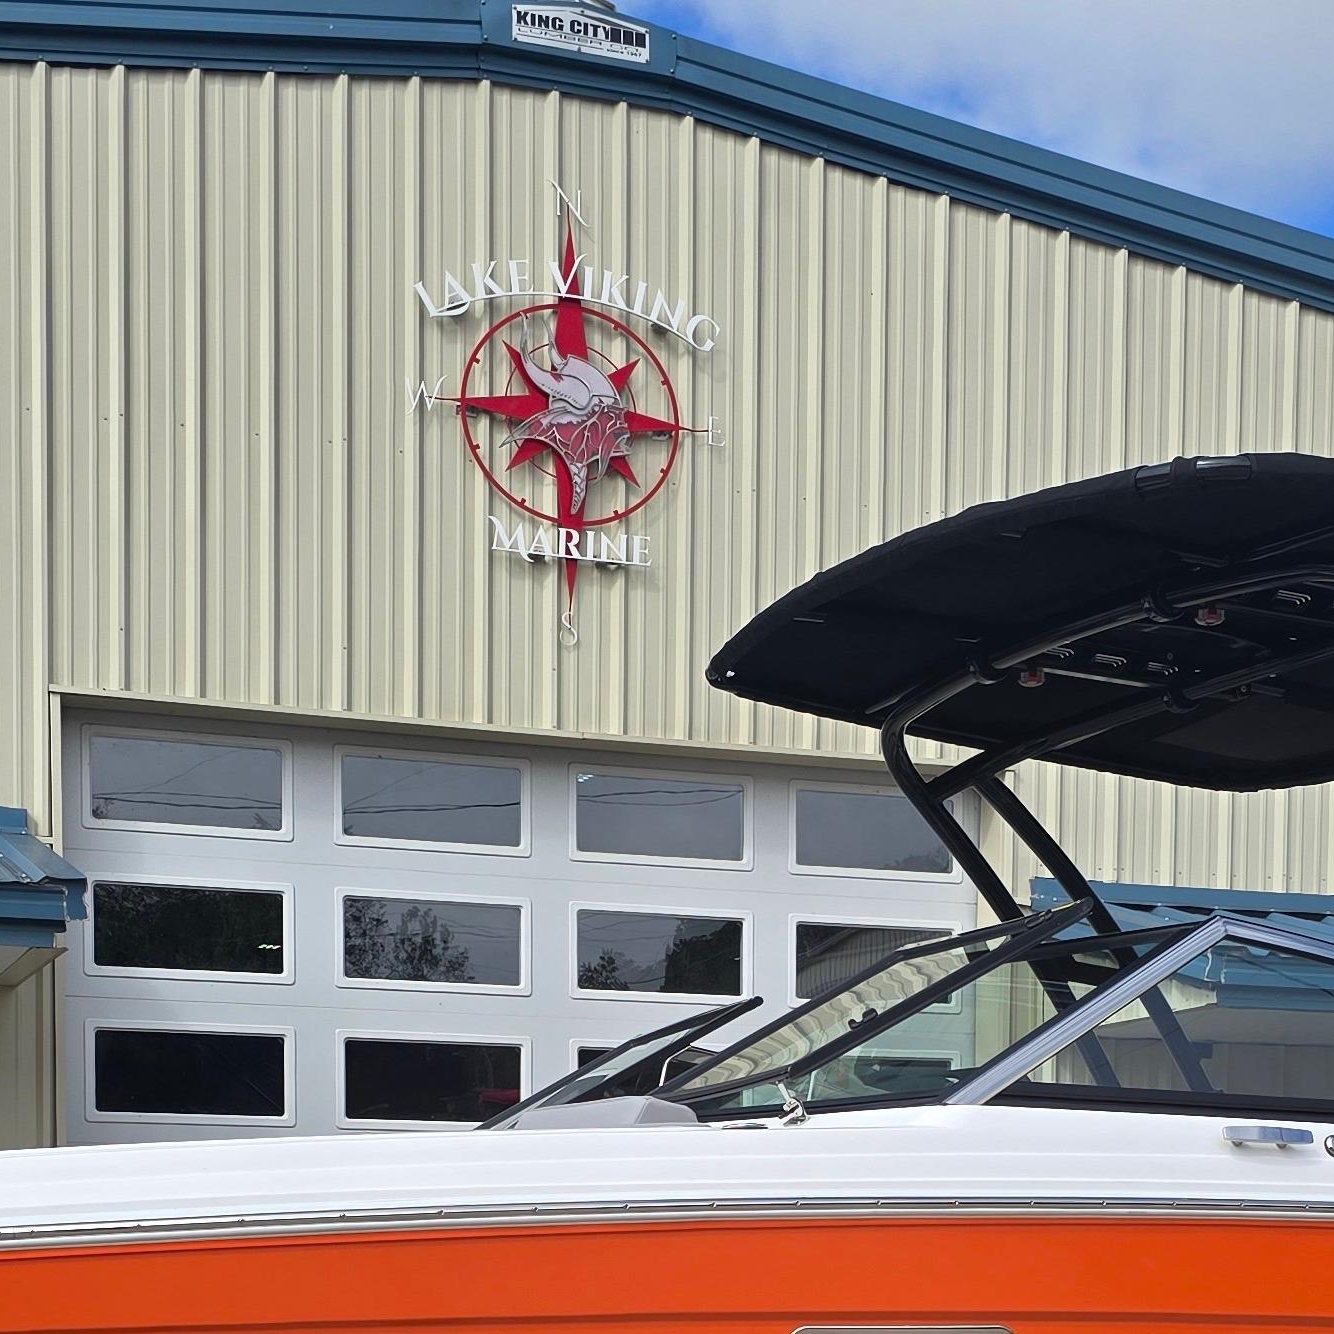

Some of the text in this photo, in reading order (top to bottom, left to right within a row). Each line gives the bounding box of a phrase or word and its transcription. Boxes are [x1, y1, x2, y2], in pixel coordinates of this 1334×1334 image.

[516, 10, 610, 40] KING CITY
[412, 253, 721, 352] LAKE VIKING
[488, 515, 653, 567] MARINE
